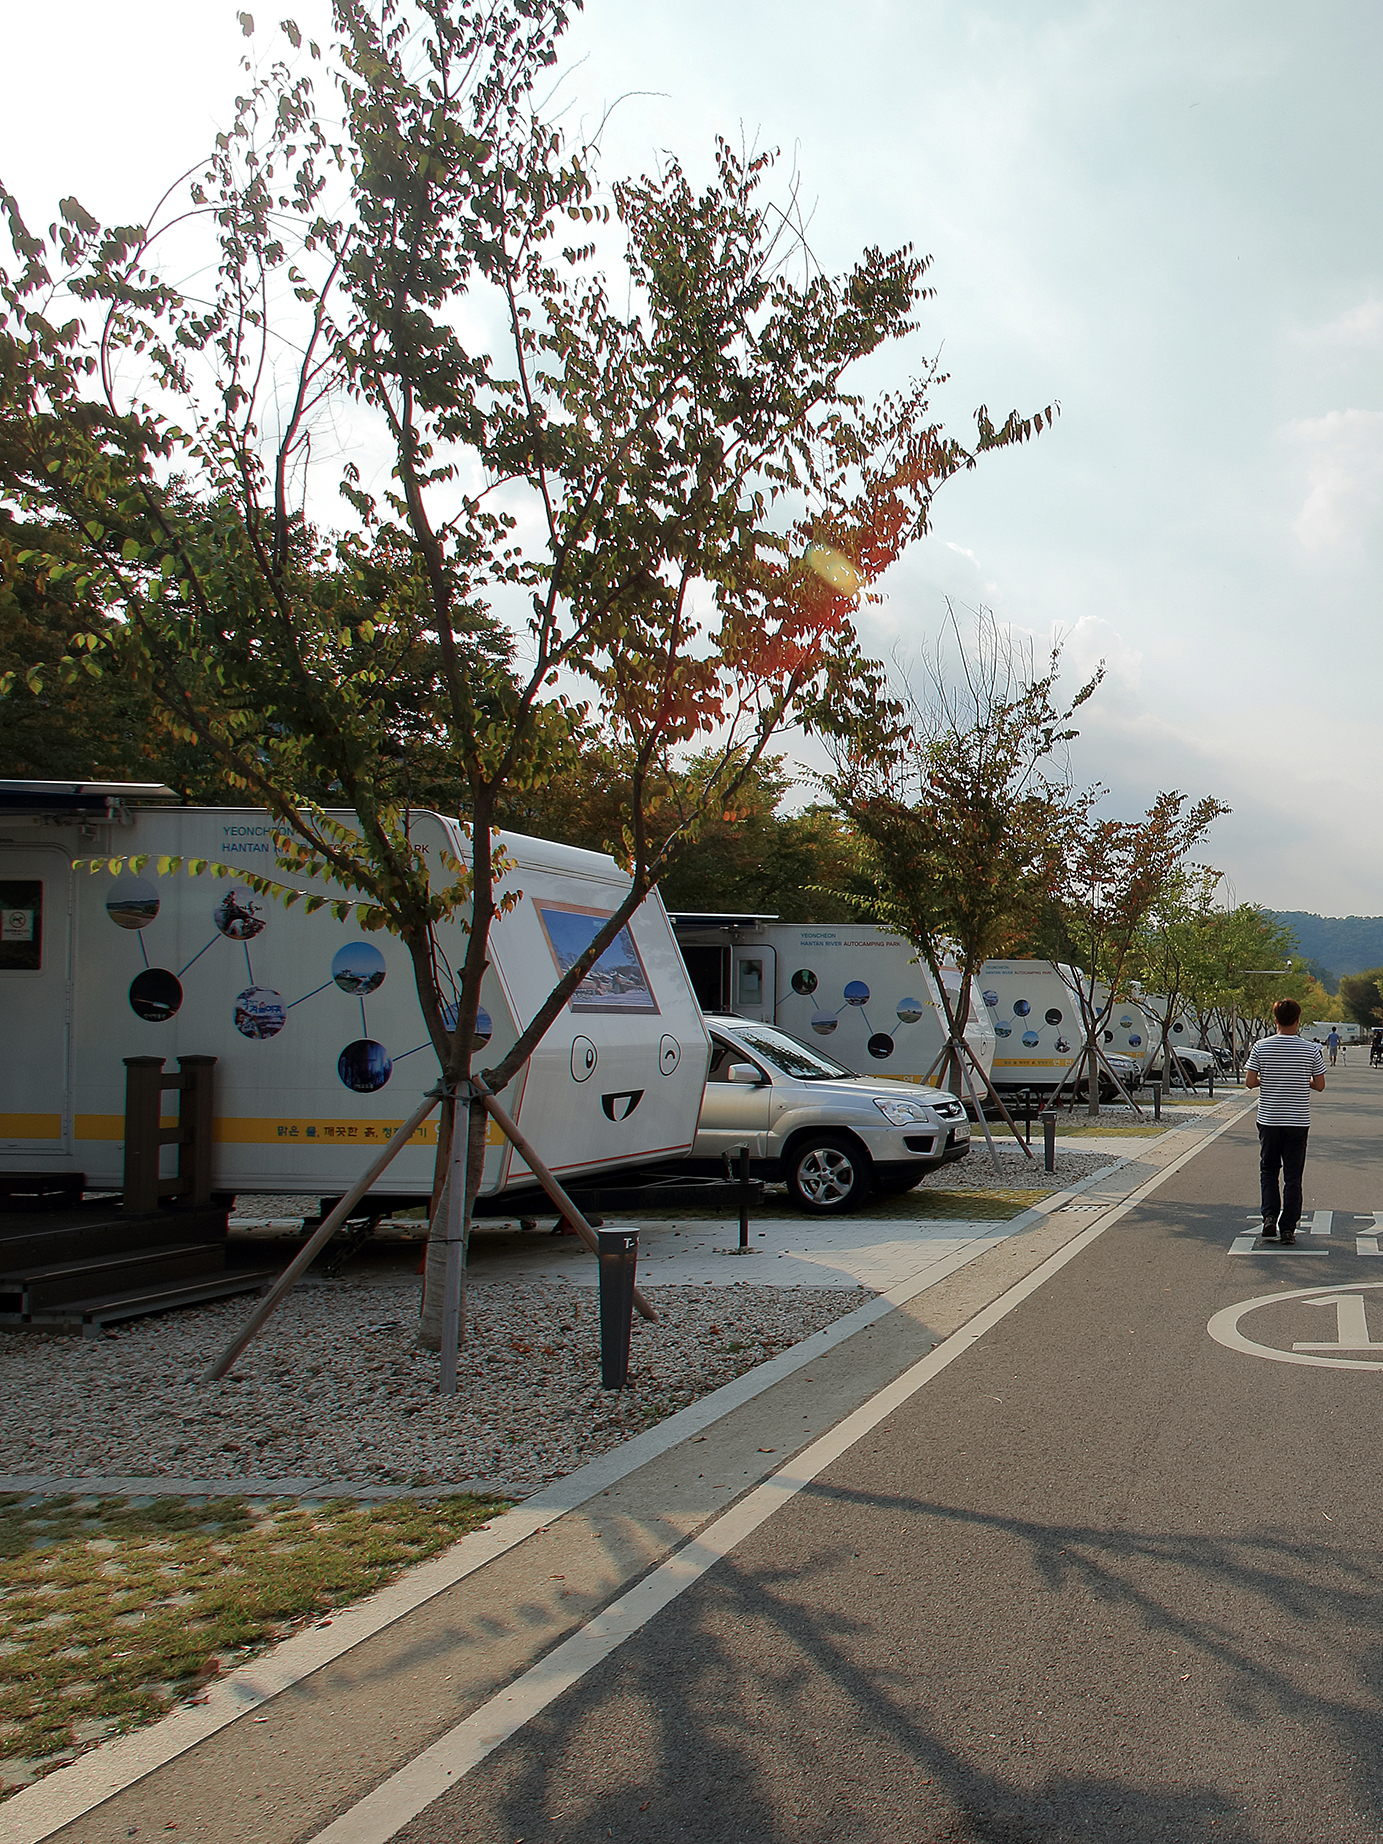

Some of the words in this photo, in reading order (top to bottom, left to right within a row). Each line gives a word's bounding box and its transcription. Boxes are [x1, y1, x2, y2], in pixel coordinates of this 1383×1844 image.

[223, 826, 294, 836] YEONCHON
[221, 843, 269, 852] HANTAN
[277, 1125, 299, 1137] 맑은
[323, 1126, 358, 1138] 깨끗한
[382, 1127, 427, 1139] 청기
